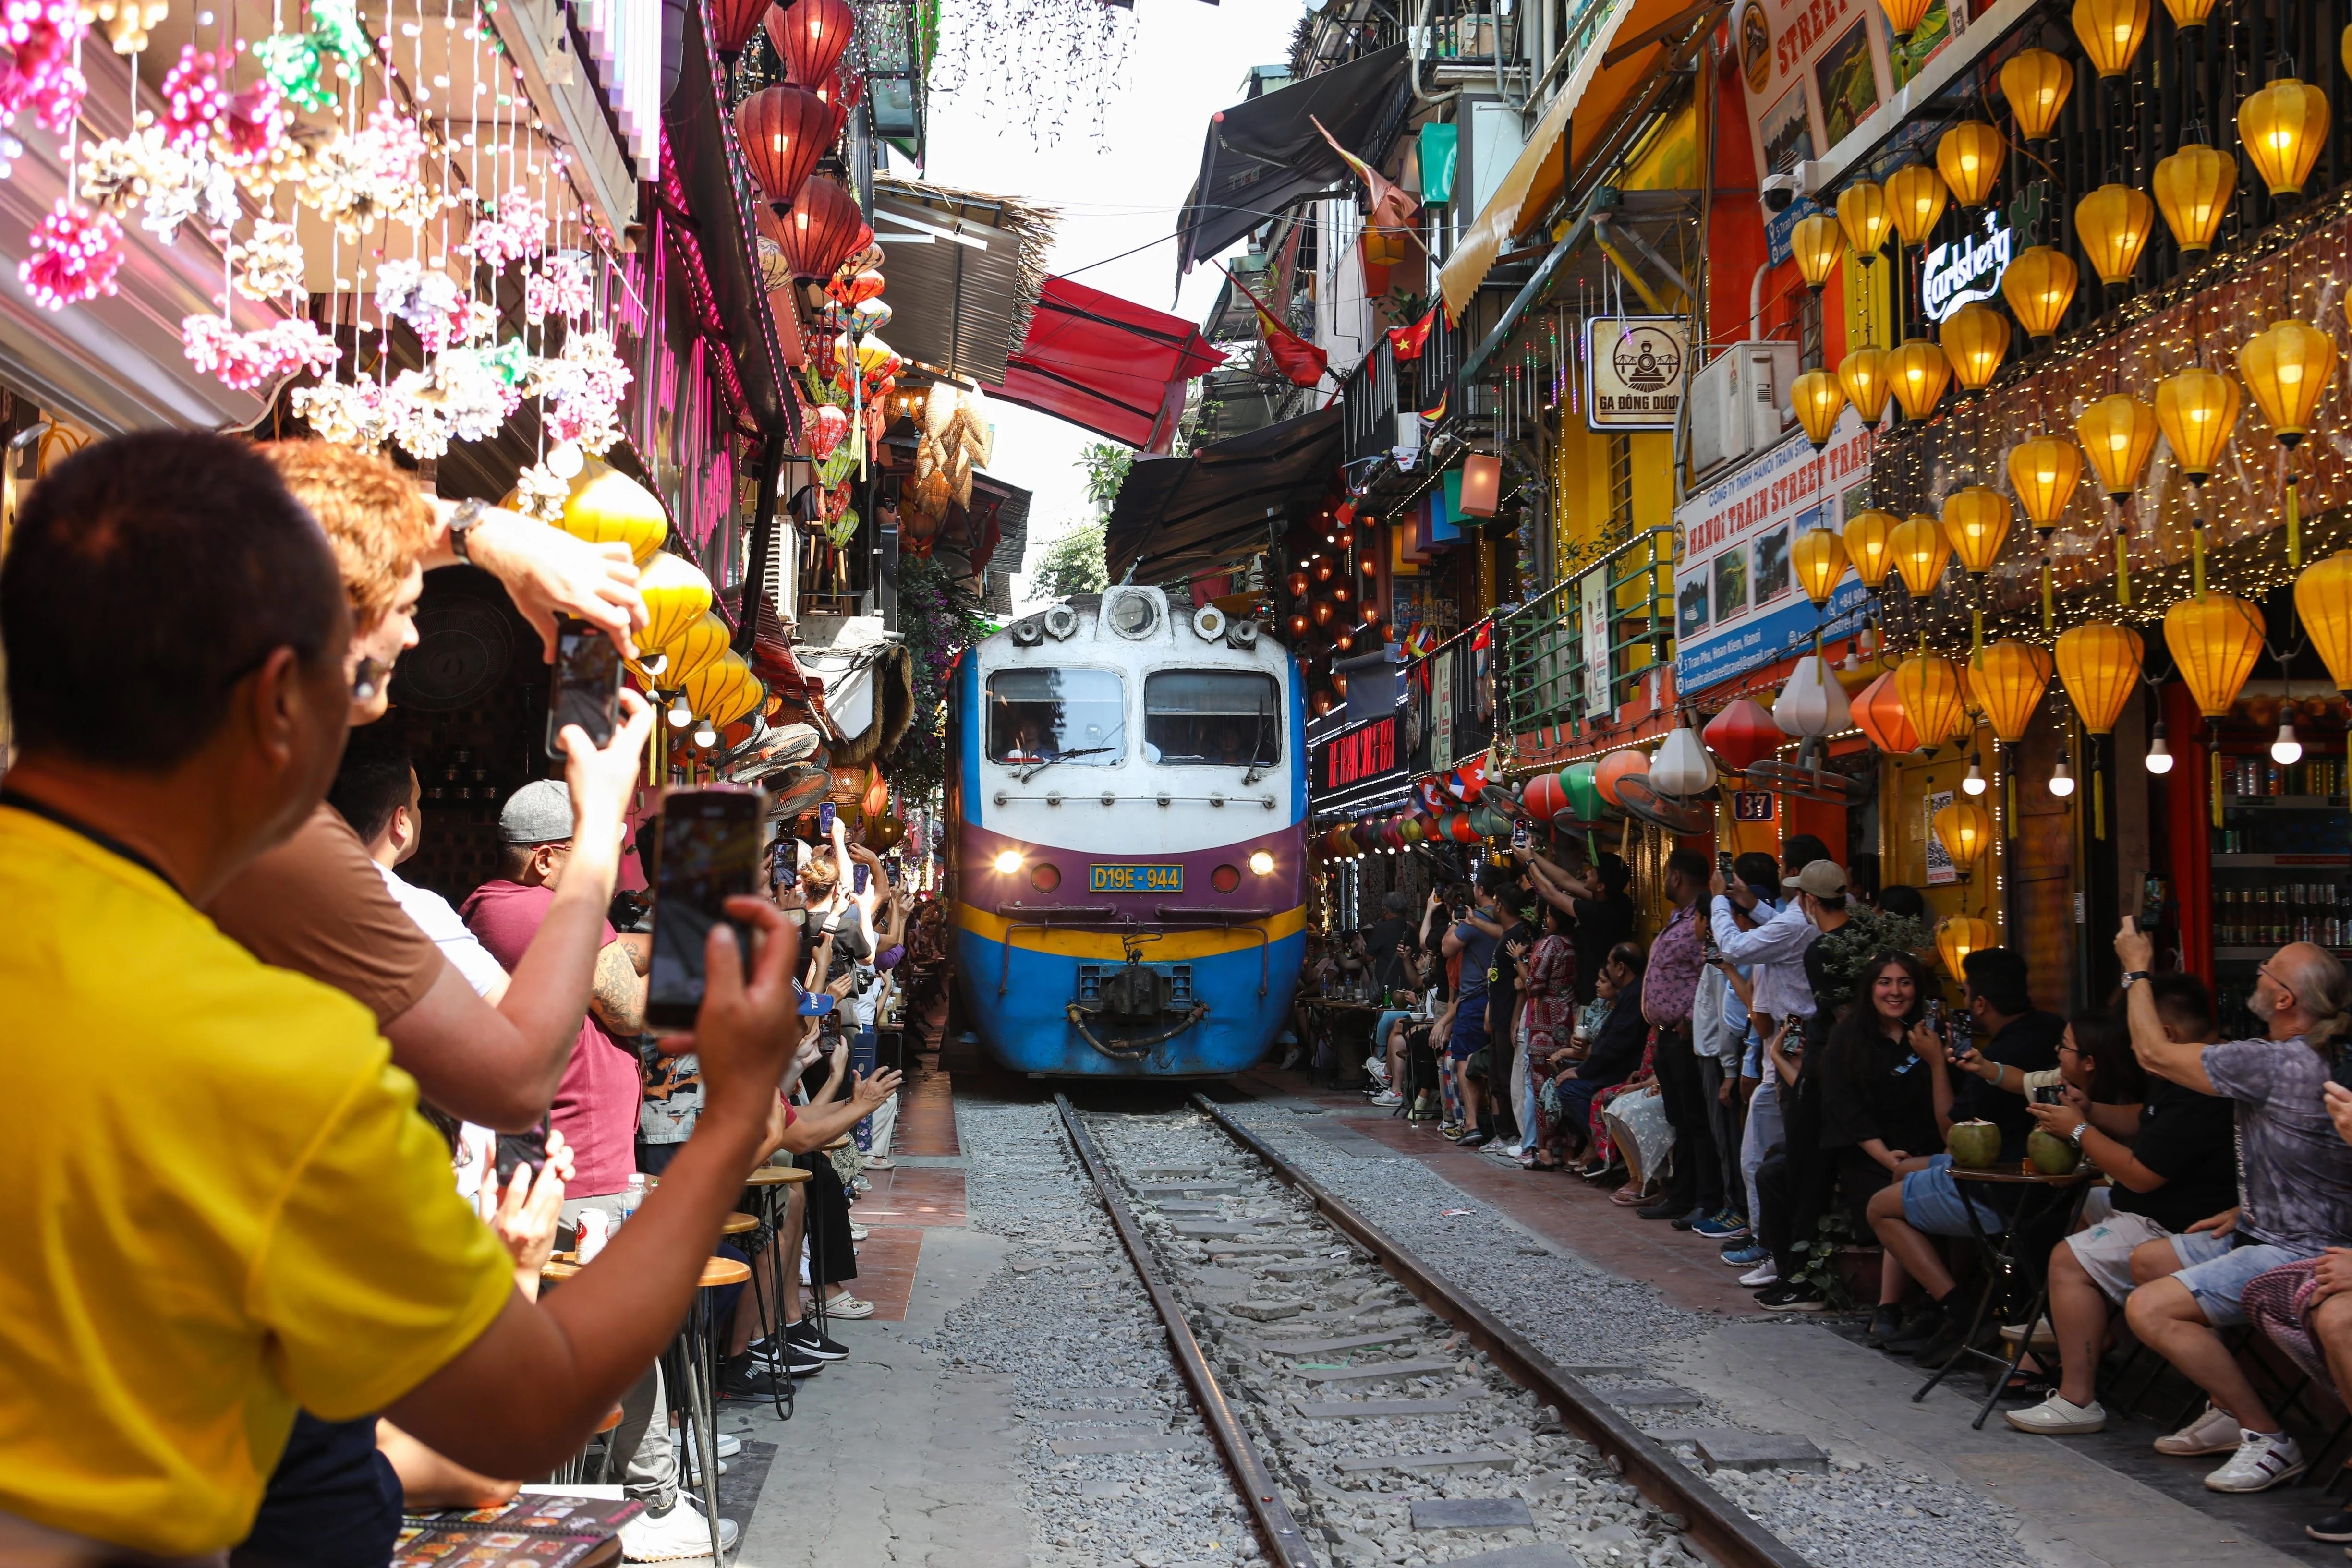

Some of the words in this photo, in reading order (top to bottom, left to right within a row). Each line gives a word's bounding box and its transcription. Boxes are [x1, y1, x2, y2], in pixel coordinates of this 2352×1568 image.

[1923, 227, 2011, 324] Carlsberg
[1600, 396, 1614, 410] GA
[1618, 394, 1649, 410] ĐÔNG
[1729, 481, 1735, 496] TY
[1754, 457, 1774, 481] HANOI
[1775, 445, 1794, 470] TRAIN
[1772, 455, 1826, 513] STREET
[1684, 659, 1689, 671] 5
[1689, 656, 1700, 669] Tran
[1712, 645, 1727, 660] Hoan
[1744, 628, 1761, 647] Hanoi
[1745, 796, 1767, 816] 37
[1095, 868, 1134, 888] D19E
[1146, 868, 1178, 888] 944
